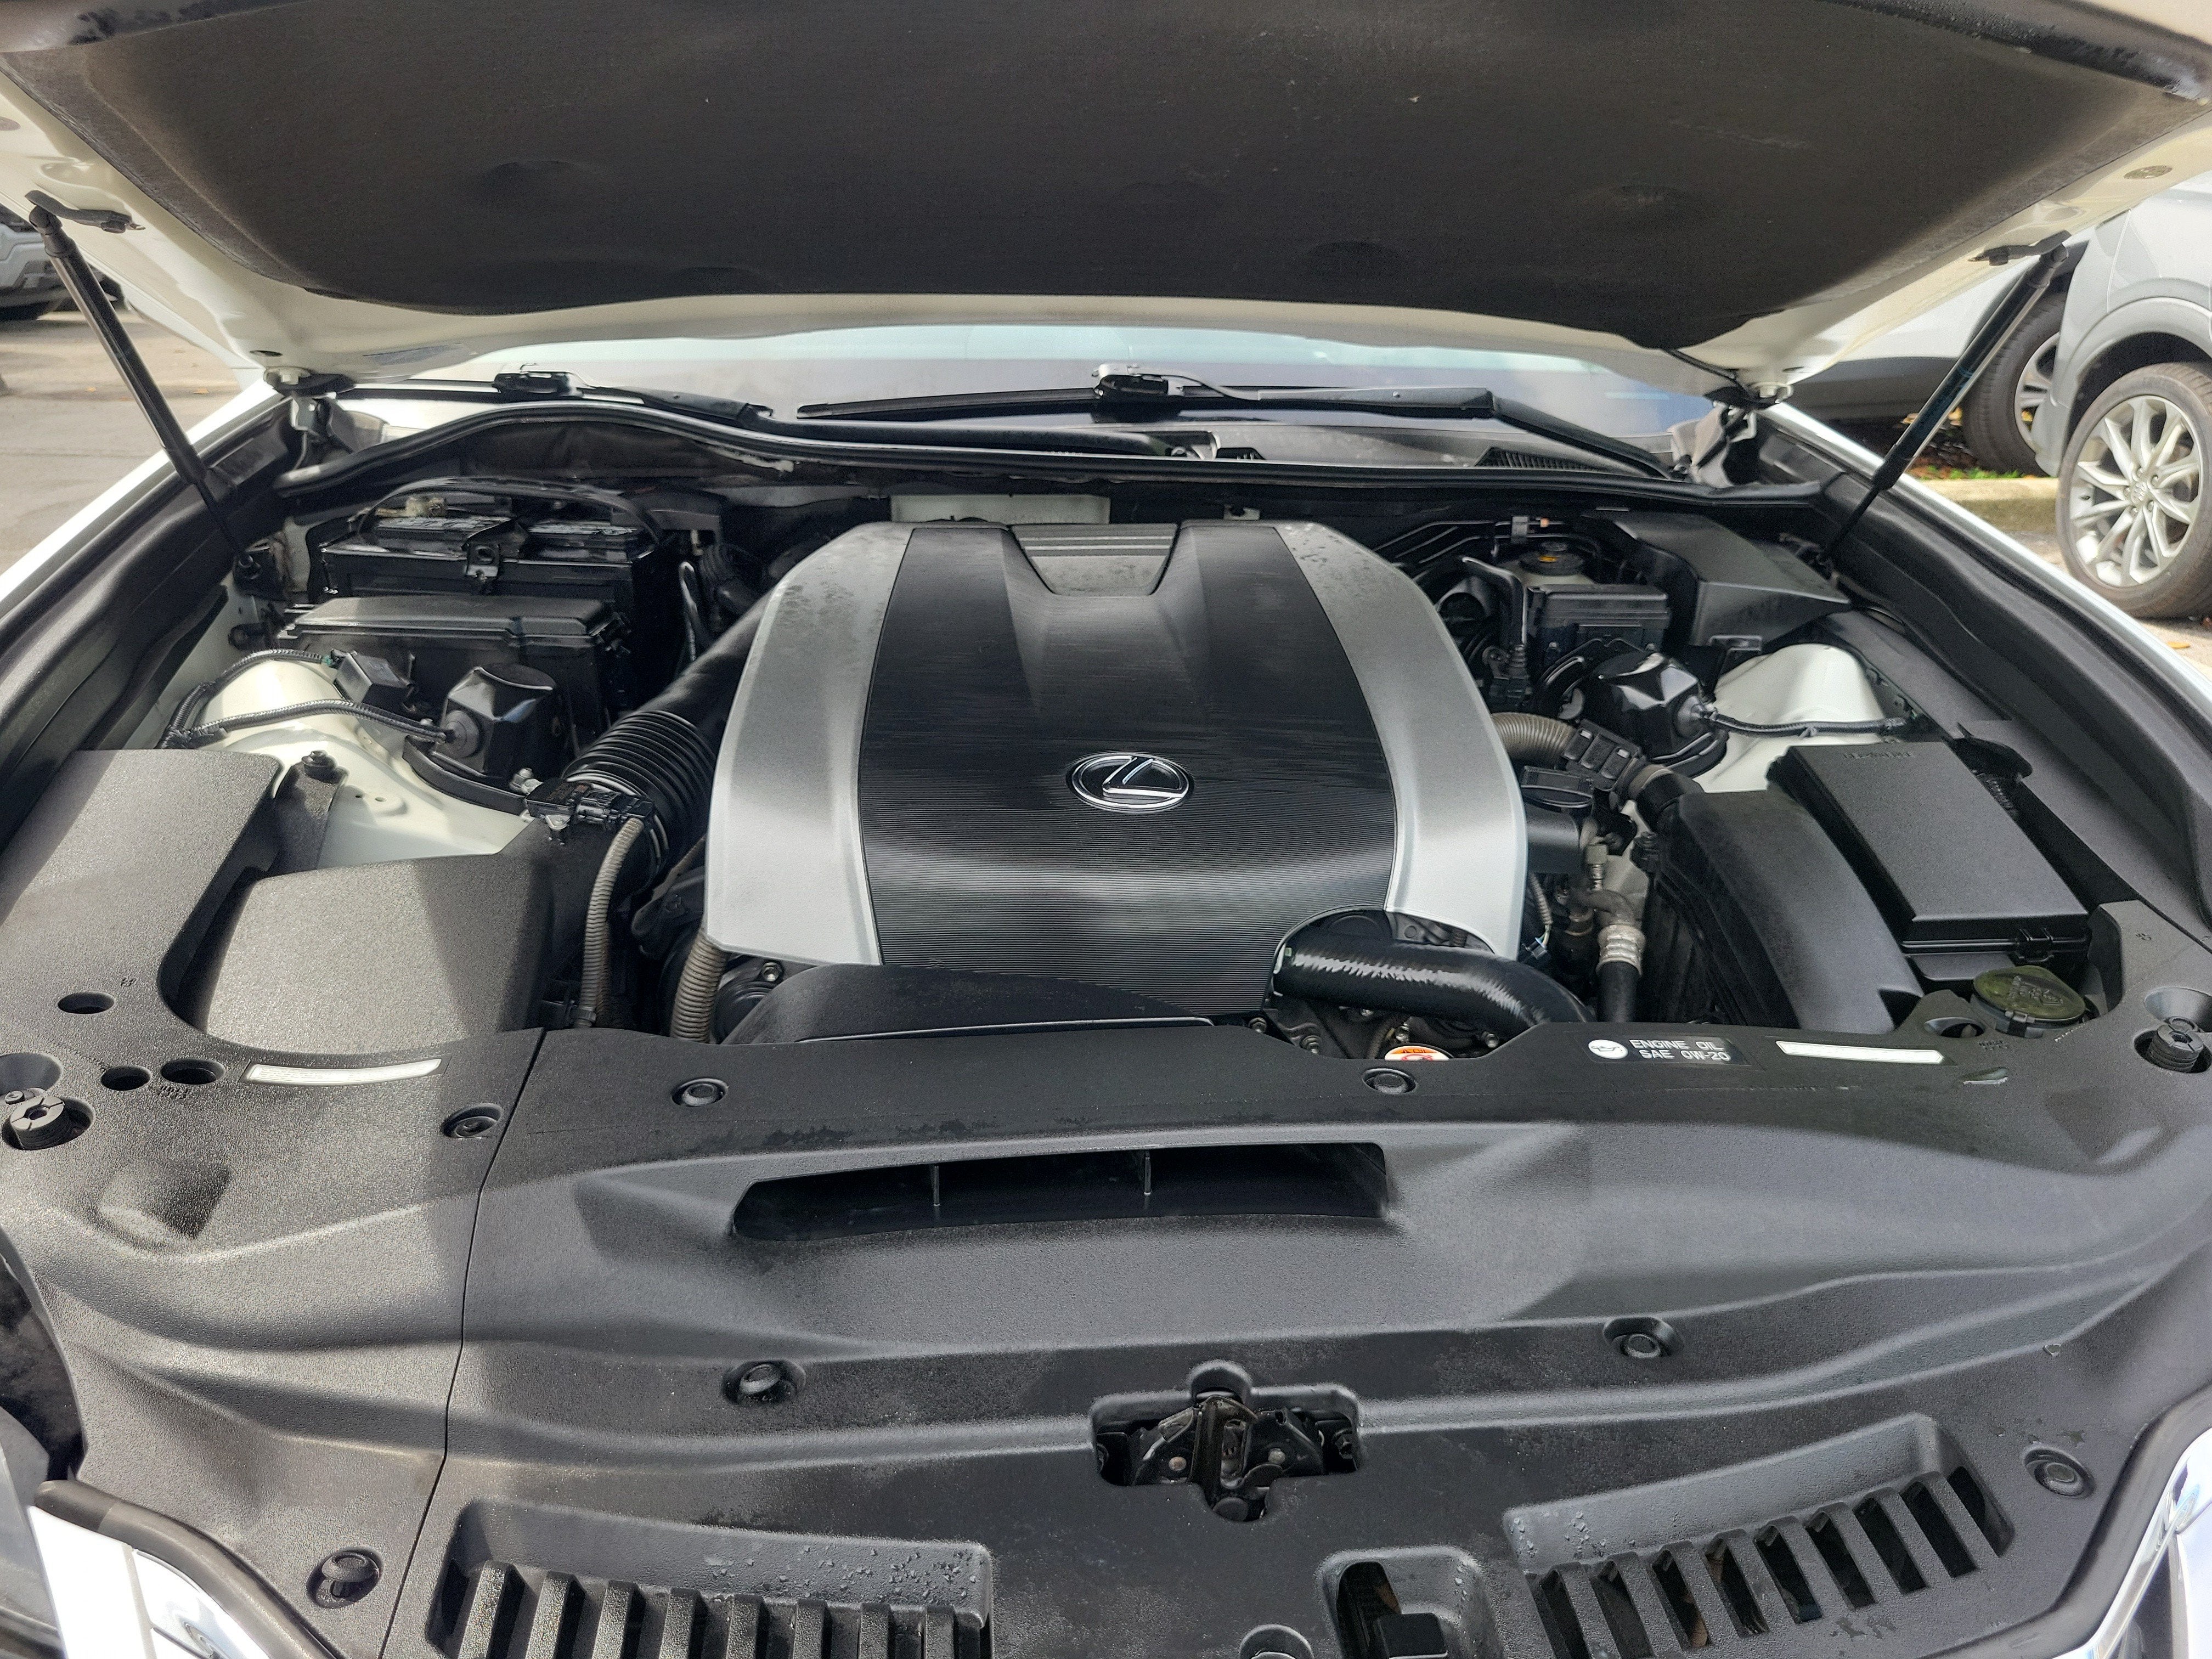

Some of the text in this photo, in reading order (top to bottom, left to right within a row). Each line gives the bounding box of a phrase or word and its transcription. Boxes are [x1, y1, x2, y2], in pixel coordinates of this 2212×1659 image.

[1629, 1039, 1725, 1050] ENGINE OIL
[1639, 1049, 1731, 1062] SAE 0W-20
